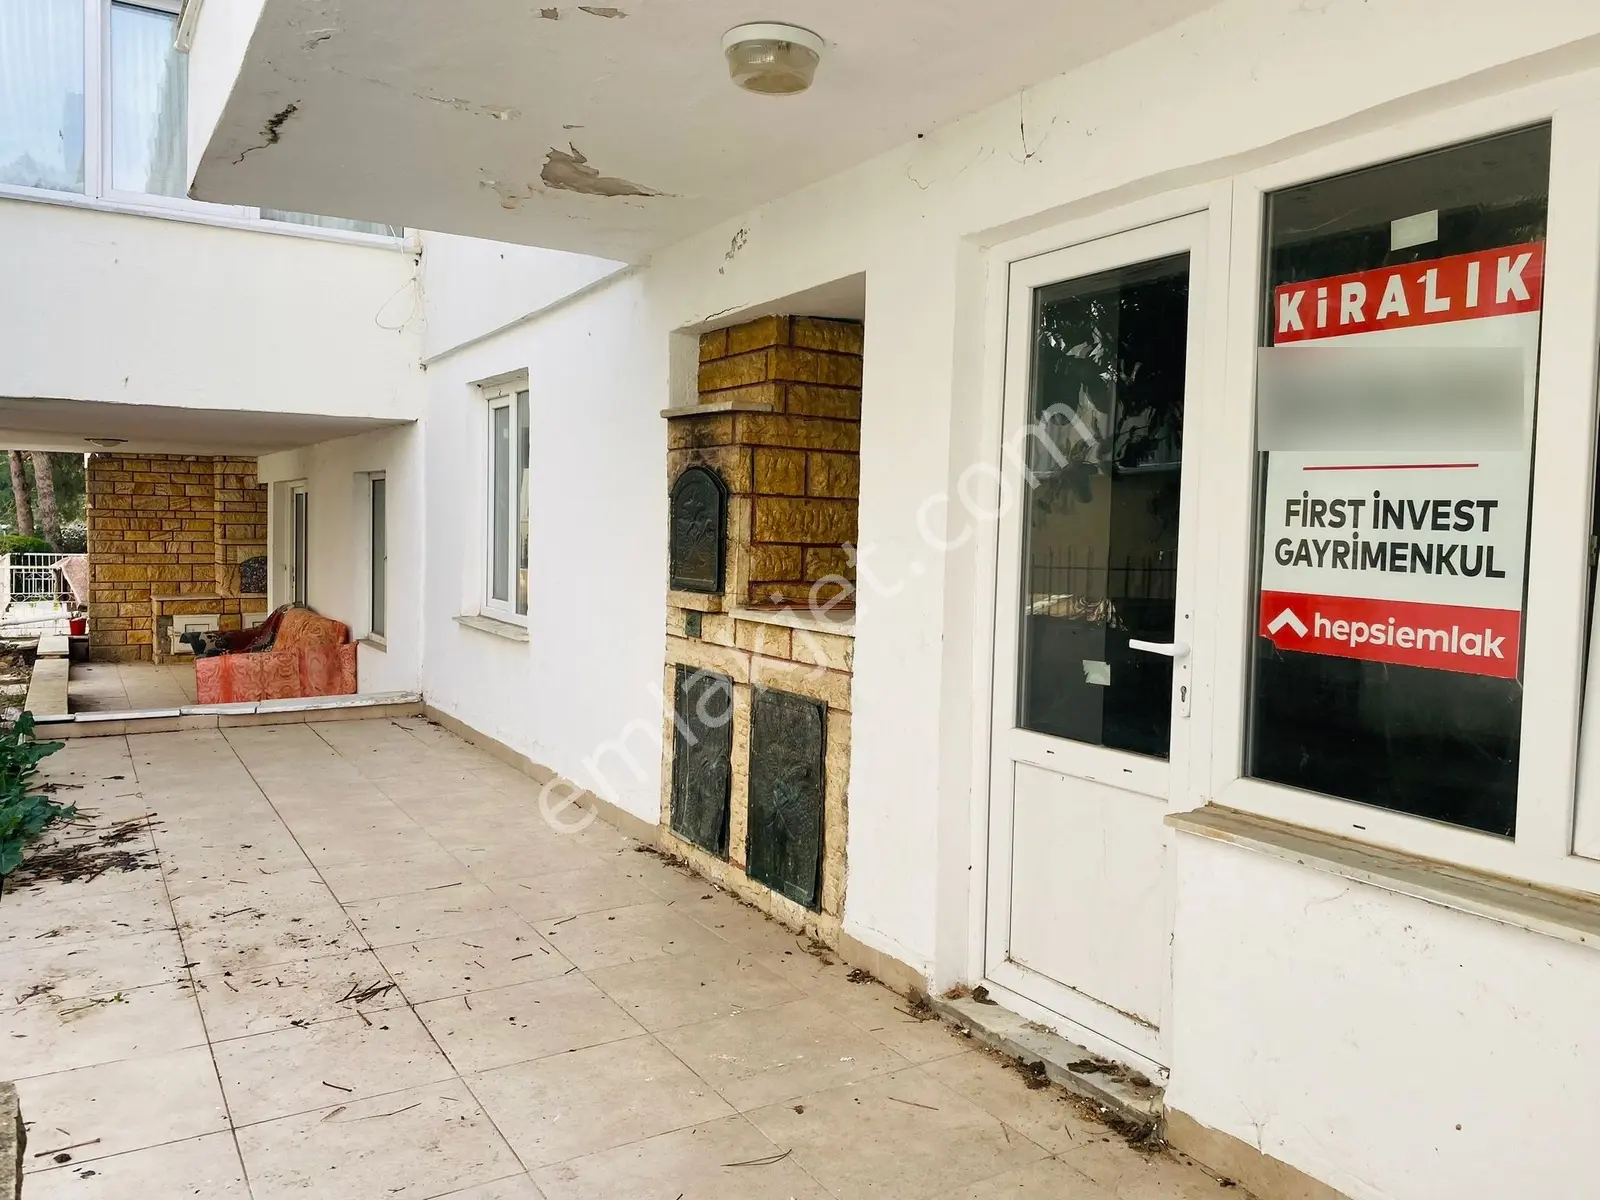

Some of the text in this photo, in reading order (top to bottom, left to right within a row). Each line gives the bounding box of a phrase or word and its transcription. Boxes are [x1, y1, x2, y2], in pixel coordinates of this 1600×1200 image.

[1285, 490, 1498, 532] FİRST İNVEST
[1275, 532, 1506, 578] GAYRİMENKUL
[1314, 612, 1506, 659] hepsiemlak
